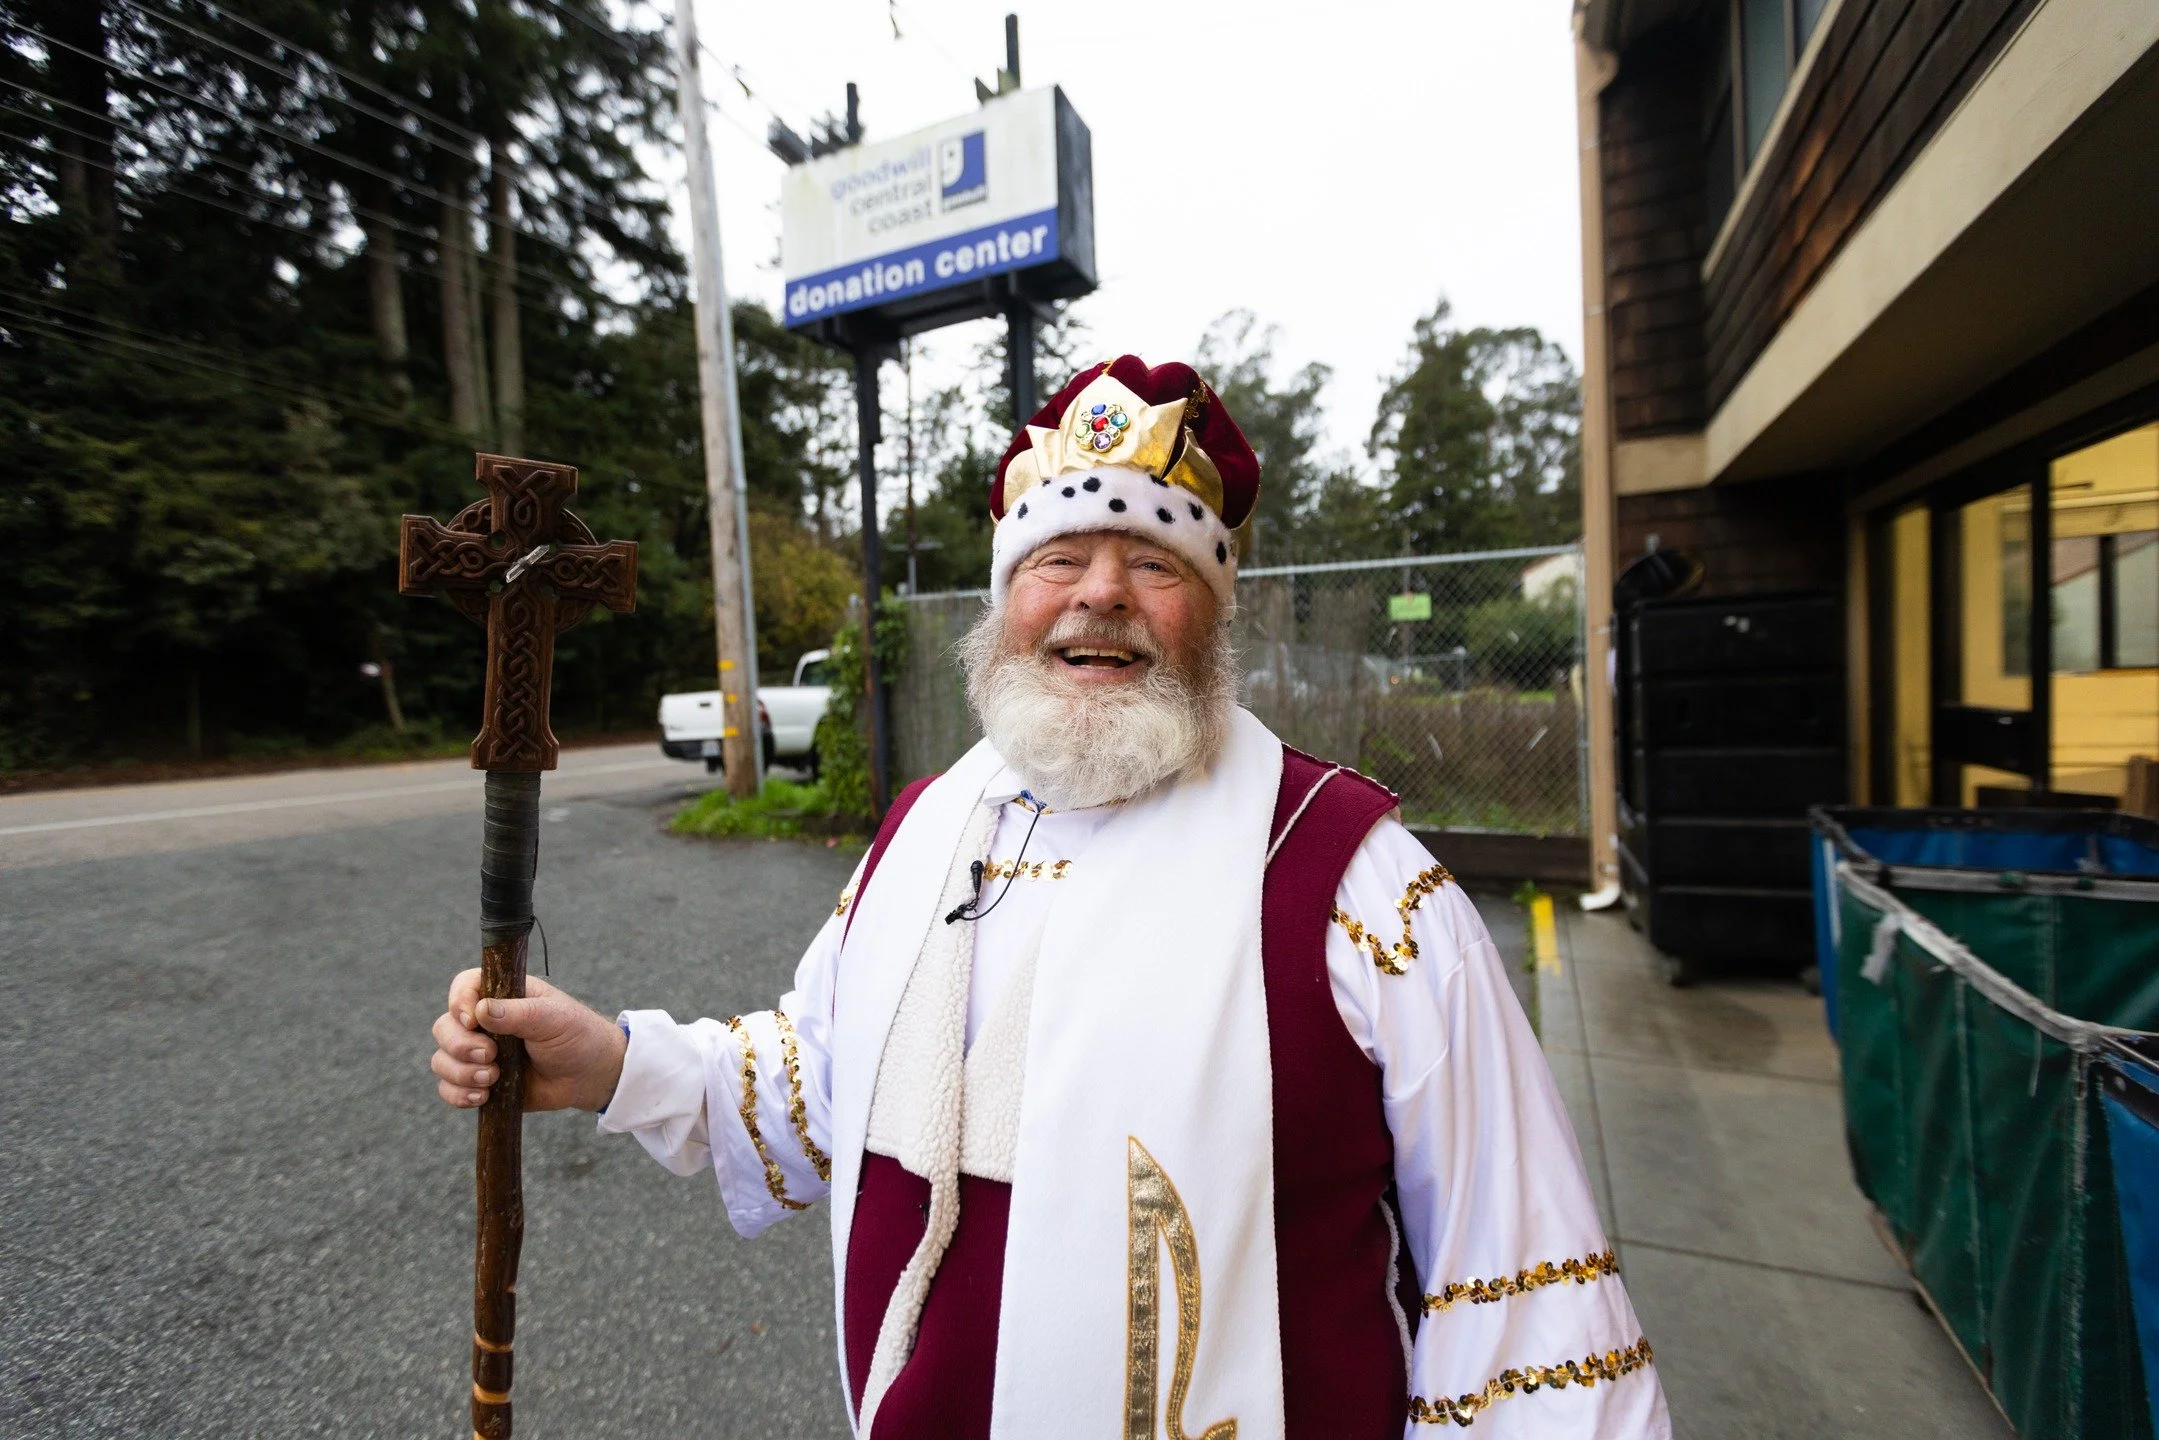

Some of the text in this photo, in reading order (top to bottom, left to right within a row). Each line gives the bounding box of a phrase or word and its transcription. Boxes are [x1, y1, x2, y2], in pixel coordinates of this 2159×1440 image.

[829, 145, 932, 200] goodwill
[849, 174, 932, 217] central
[867, 198, 932, 236] coast
[788, 224, 1046, 317] donation center
